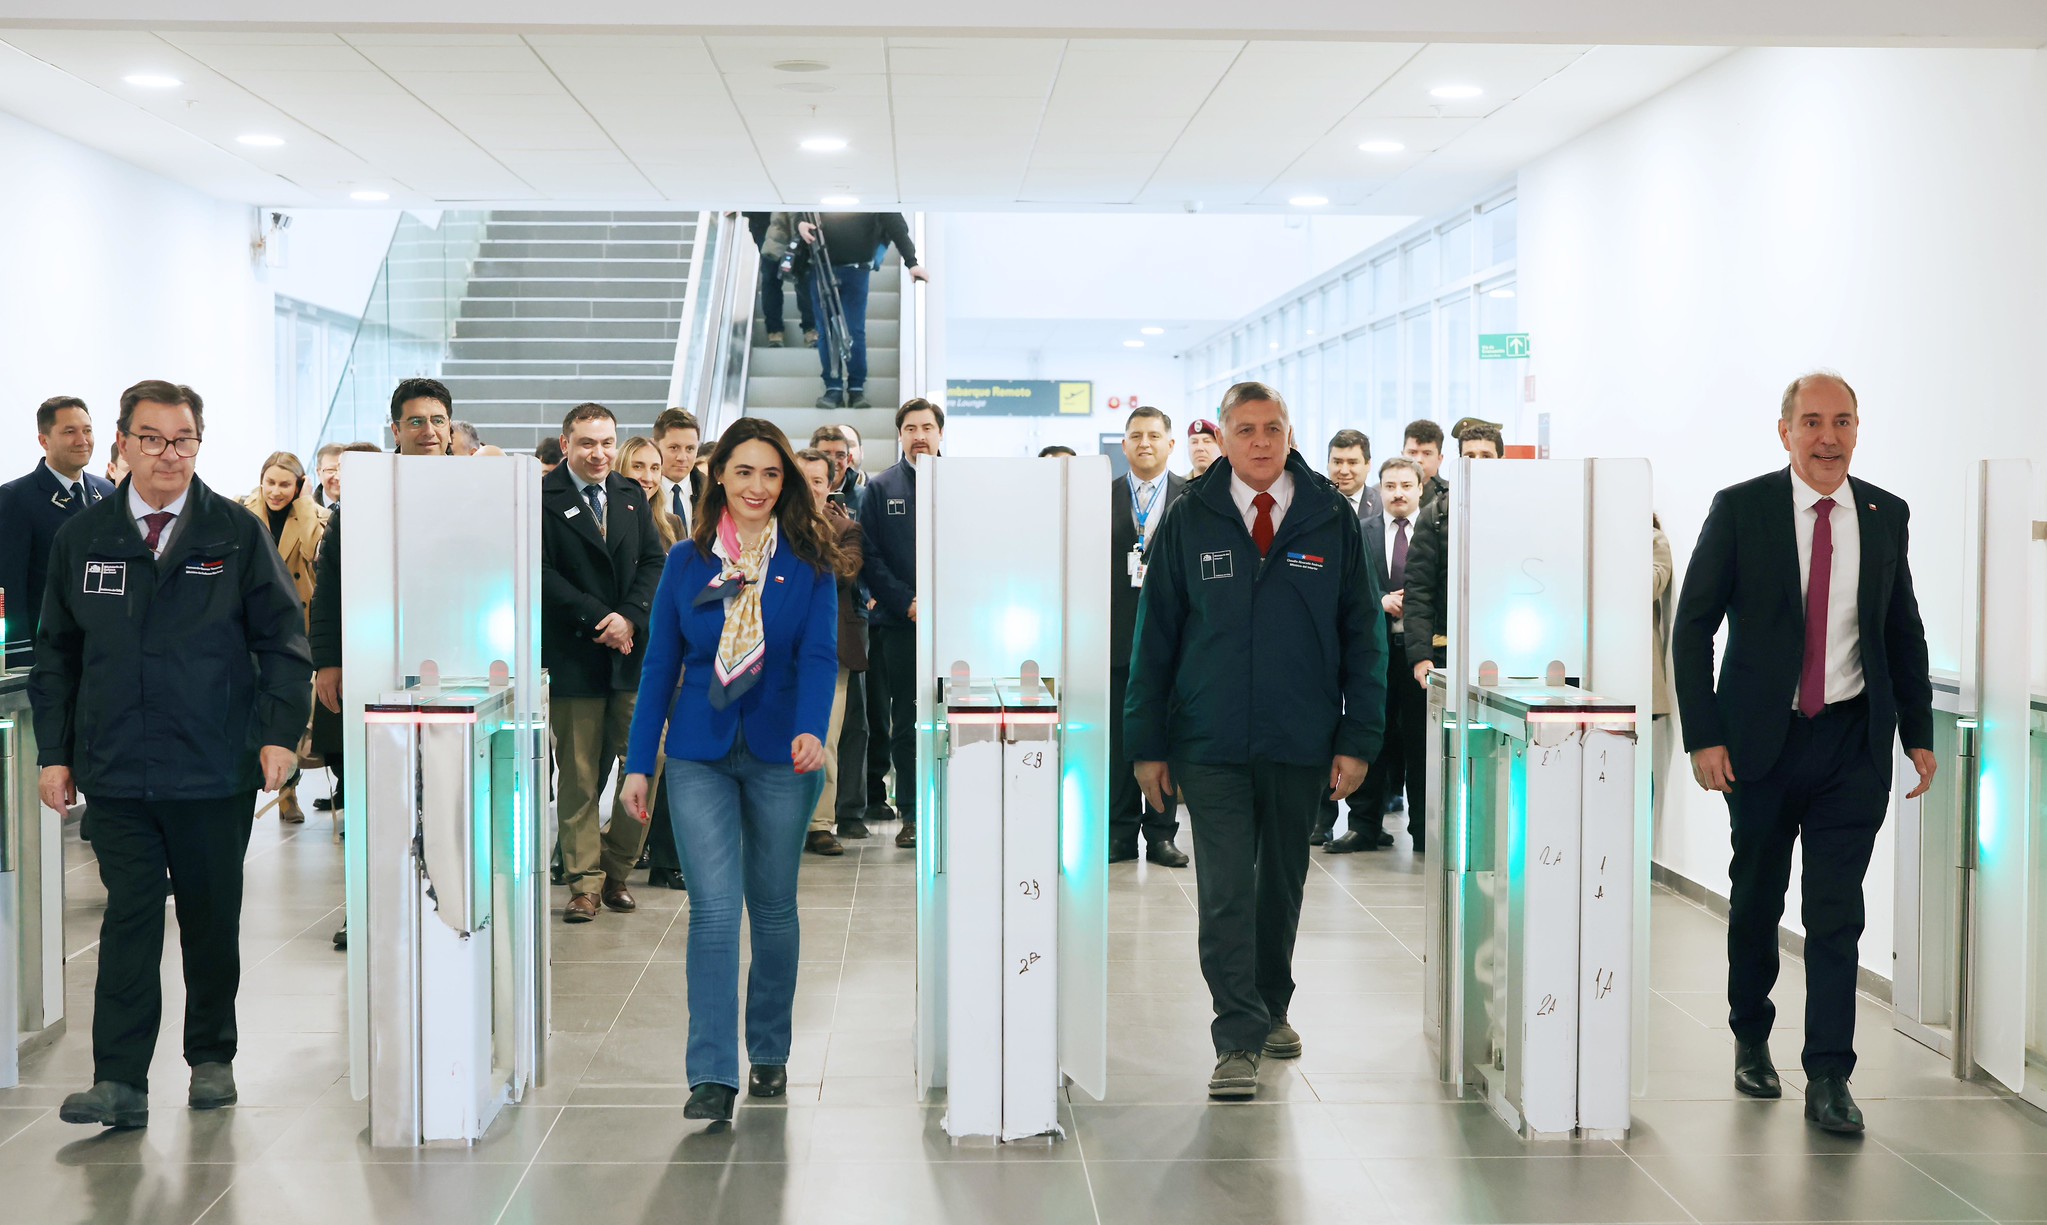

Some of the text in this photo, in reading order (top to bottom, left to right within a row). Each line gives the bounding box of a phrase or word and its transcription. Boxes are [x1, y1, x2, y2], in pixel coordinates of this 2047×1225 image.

[992, 386, 1032, 398] Remoto
[957, 399, 987, 409] Lounge
[1511, 557, 1546, 595] S
[1595, 967, 1613, 1000] 1A
[1536, 993, 1557, 1016] 2A
